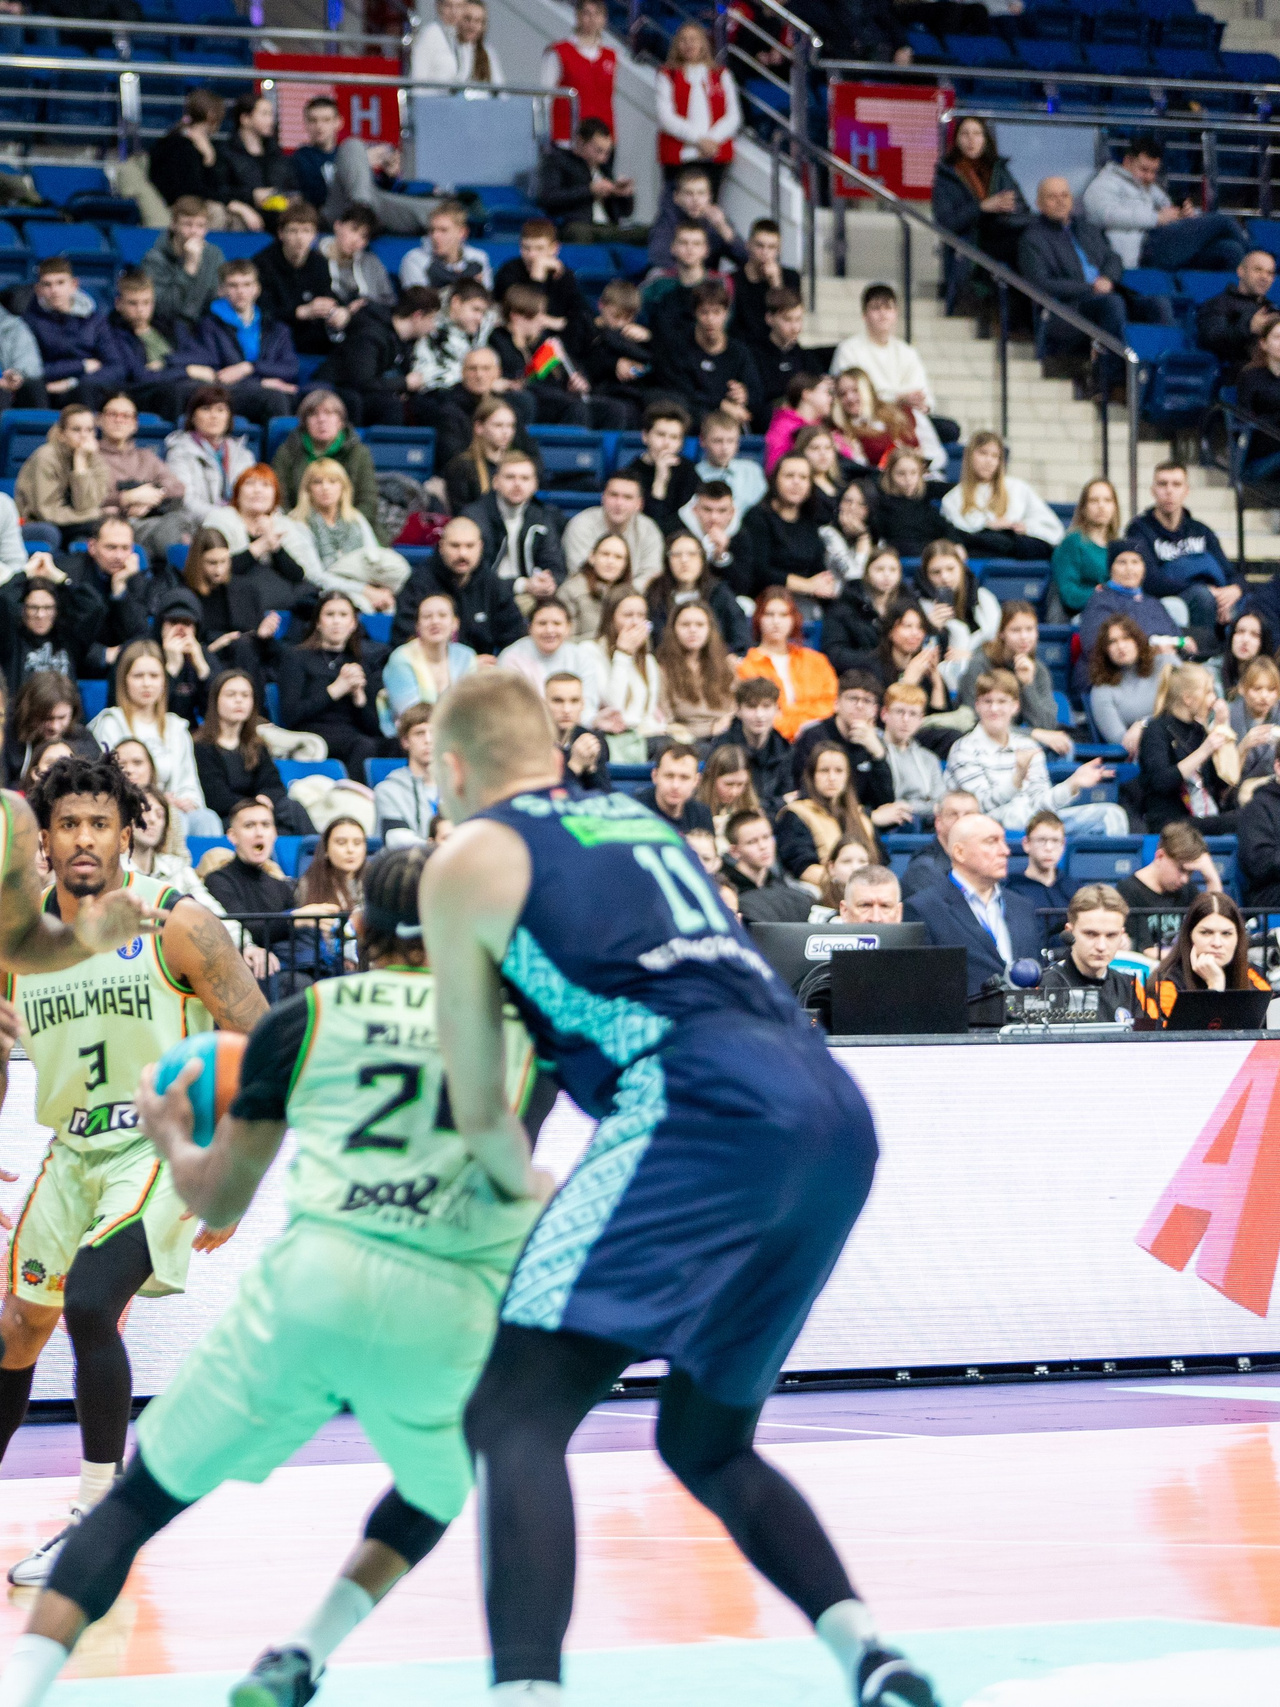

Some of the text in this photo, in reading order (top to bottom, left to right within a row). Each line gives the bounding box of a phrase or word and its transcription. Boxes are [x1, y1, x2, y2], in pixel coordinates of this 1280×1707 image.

[22, 973, 150, 999] SVERDLOVSK REGION
[23, 984, 153, 1037] URALMASH
[78, 1040, 109, 1092] 3
